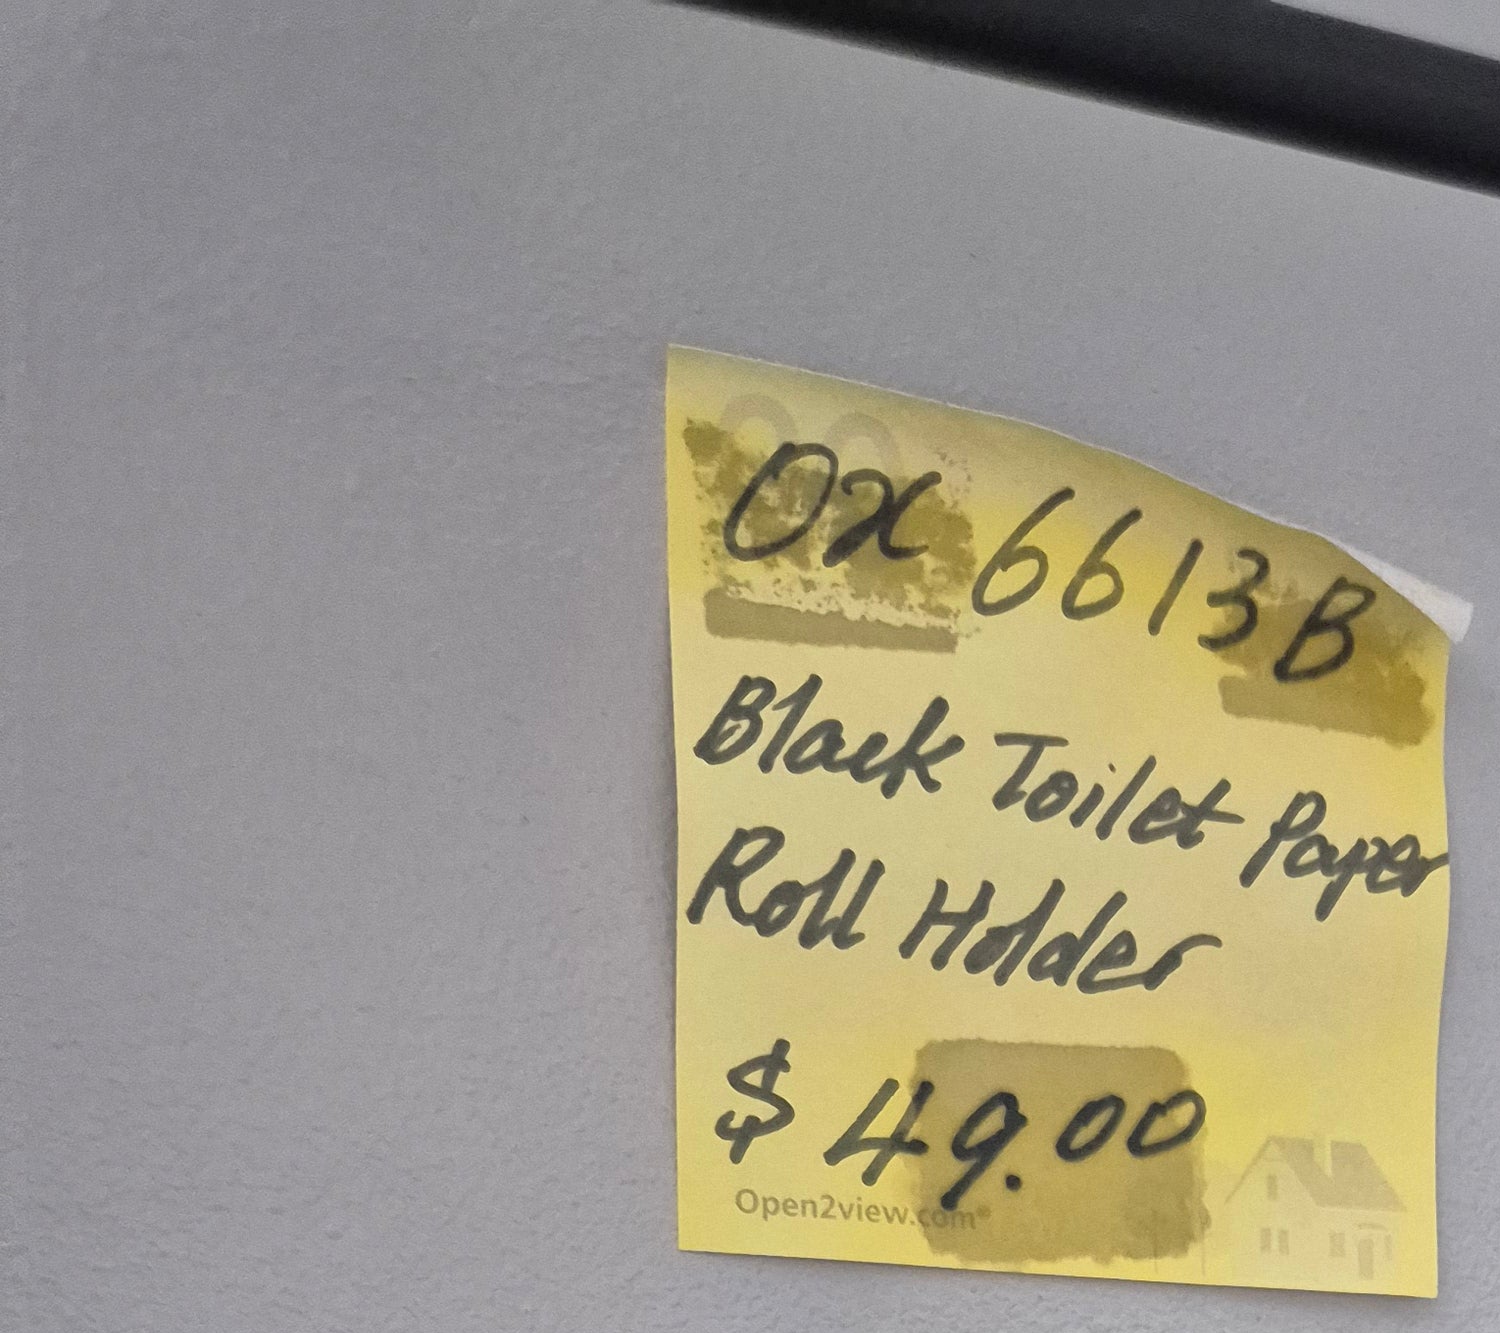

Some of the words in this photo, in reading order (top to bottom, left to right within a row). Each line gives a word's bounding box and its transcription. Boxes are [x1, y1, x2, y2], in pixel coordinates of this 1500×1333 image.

[692, 674, 966, 799] Black
[994, 731, 1244, 849] Toilet
[1239, 790, 1449, 921] Paper
[686, 826, 887, 951] Roll
[898, 878, 1223, 996] Holder
